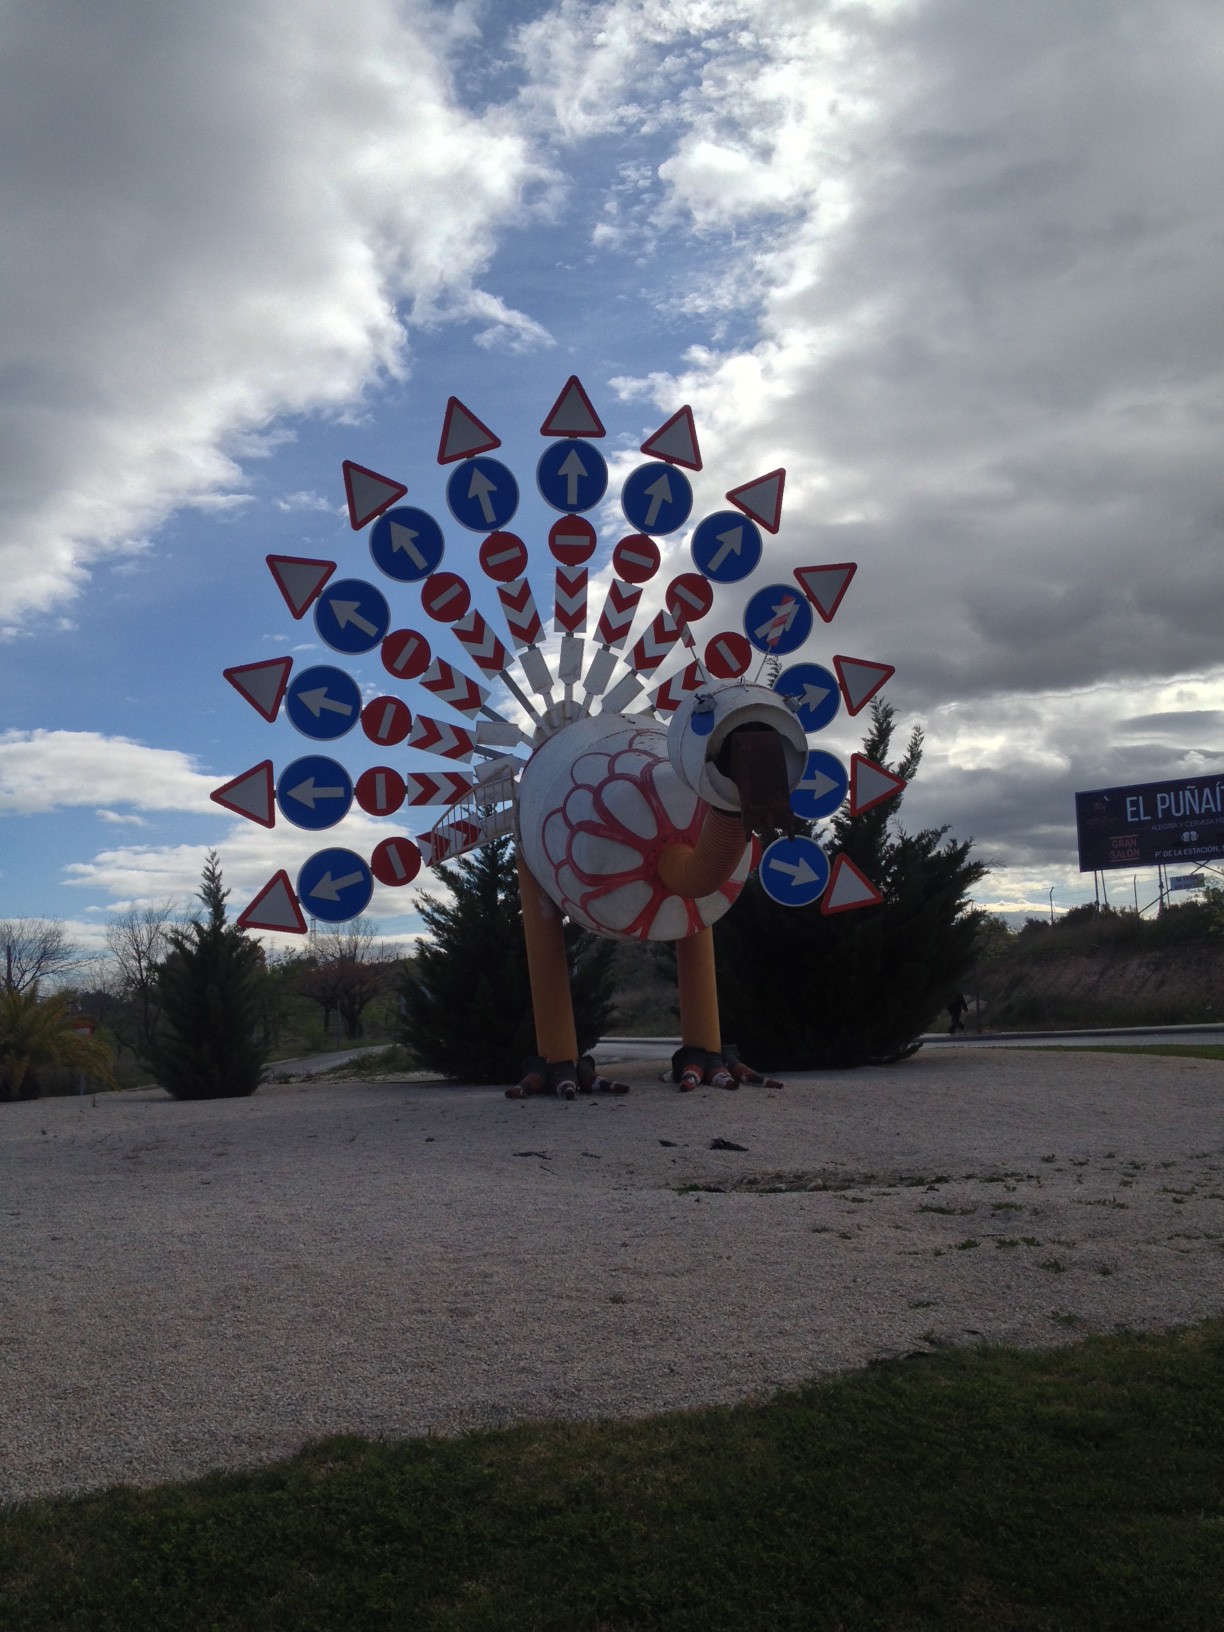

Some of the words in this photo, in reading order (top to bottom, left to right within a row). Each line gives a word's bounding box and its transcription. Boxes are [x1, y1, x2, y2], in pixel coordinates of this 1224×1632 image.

[1126, 796, 1151, 822] EL
[1156, 781, 1224, 818] PUÑAÍ
[1112, 838, 1137, 849] GRAN
[1163, 850, 1173, 858] DE
[1173, 849, 1183, 857] LA
